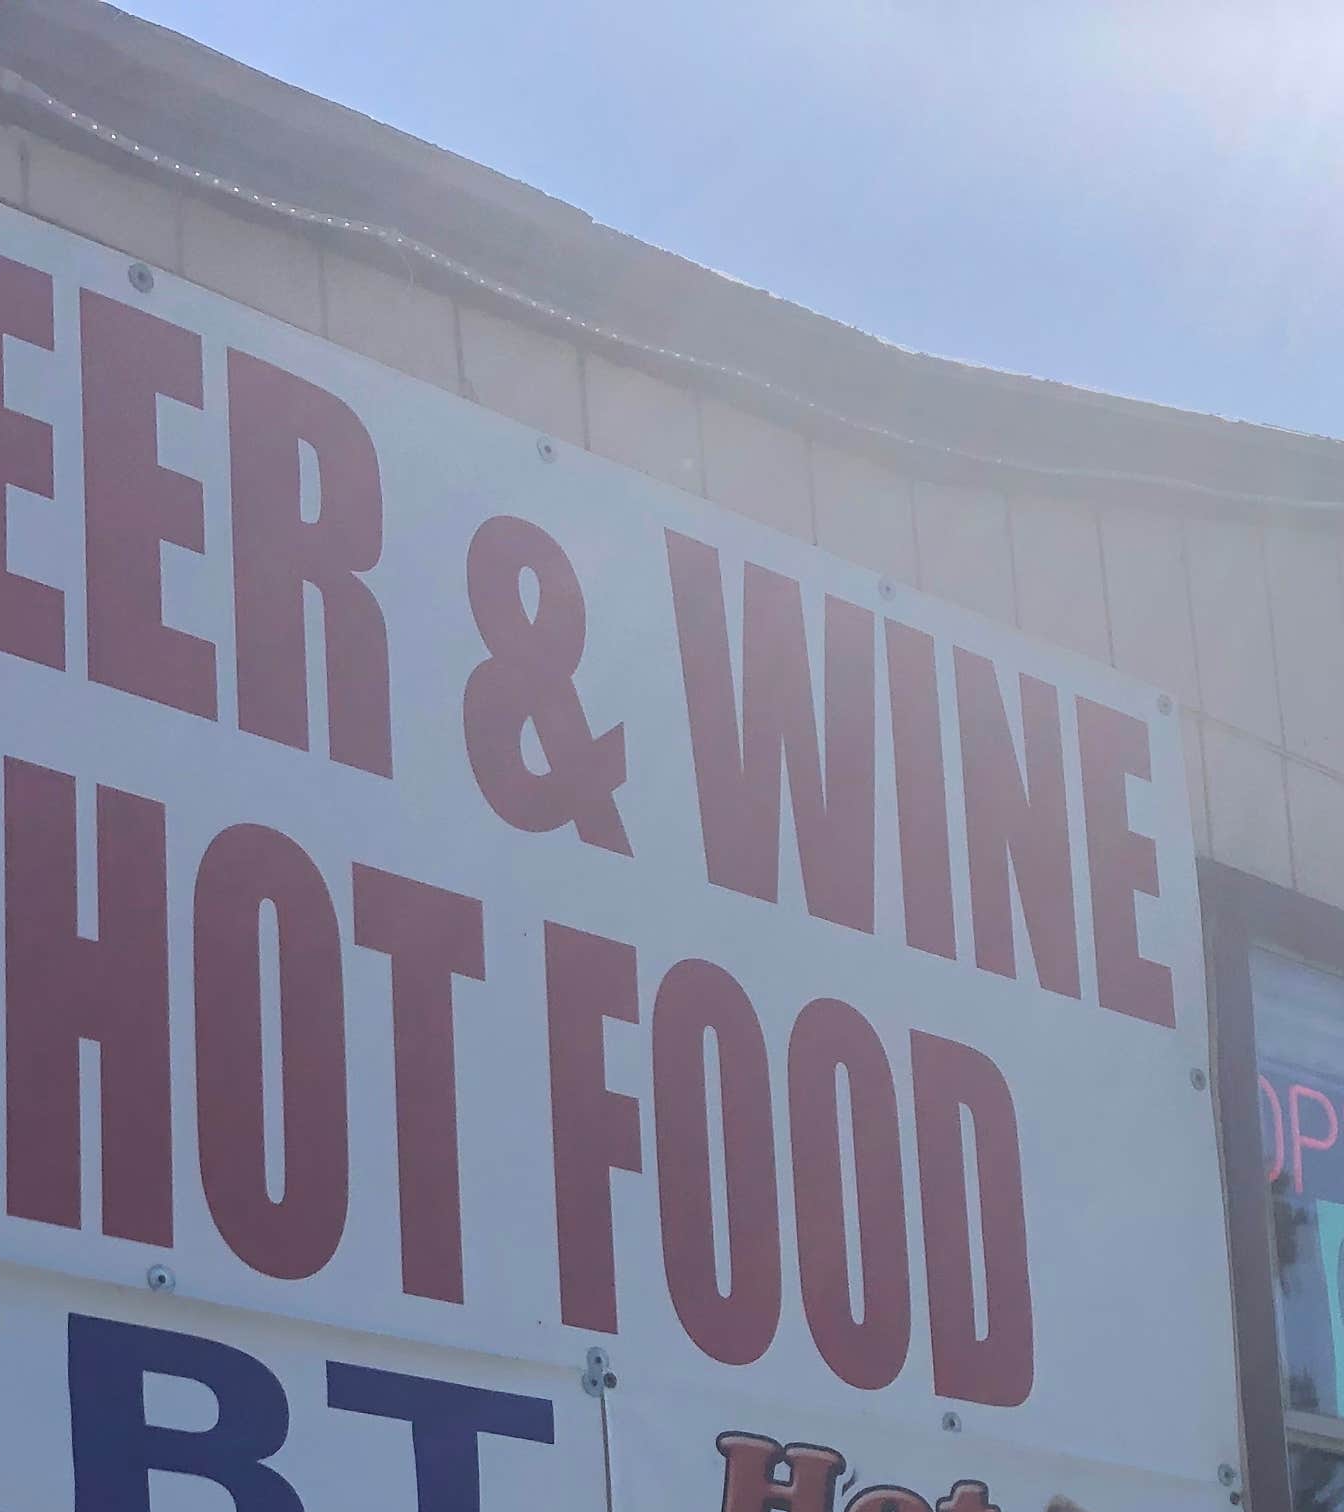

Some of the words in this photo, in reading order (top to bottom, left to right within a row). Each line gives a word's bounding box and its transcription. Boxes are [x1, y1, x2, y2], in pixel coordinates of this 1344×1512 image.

[462, 515, 635, 858] &
[665, 527, 1176, 1029] WINE
[3, 756, 487, 1304] HOT
[544, 920, 1034, 1408] FOOD
